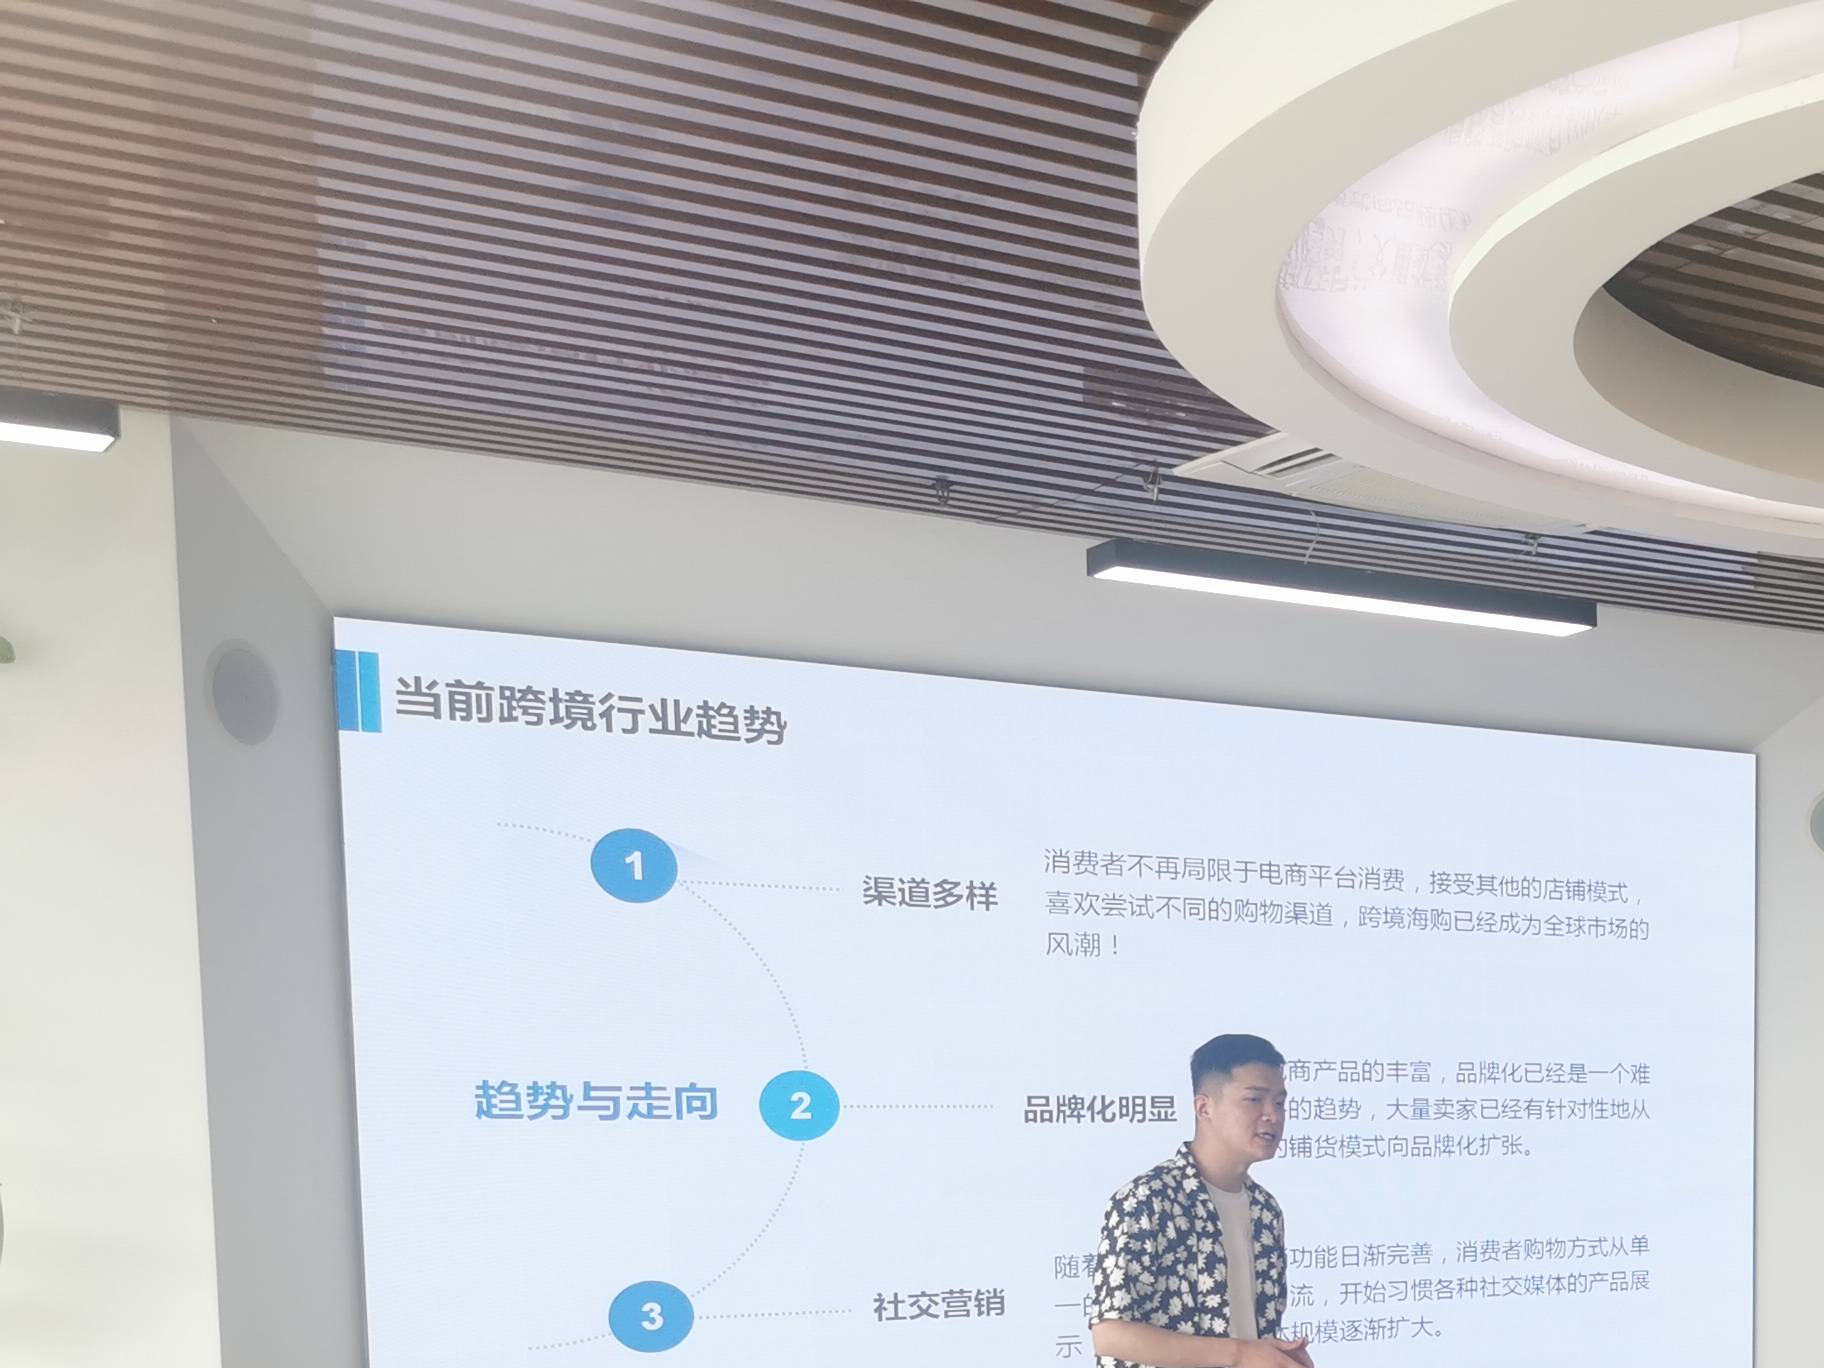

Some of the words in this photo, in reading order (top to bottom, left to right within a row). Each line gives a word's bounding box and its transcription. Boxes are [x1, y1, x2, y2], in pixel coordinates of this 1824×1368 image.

[394, 674, 788, 746] 当前跨境行业趋势
[623, 849, 645, 882] 1
[860, 874, 999, 912] 渠道多样
[1045, 890, 1650, 942] 喜欢尝试不同的购物渠道，跨境海购已经成为全球市场的
[1045, 930, 1120, 958] 风潮！
[1281, 1058, 1651, 1087] 商产品的丰富，品牌化已经是一个难
[474, 1079, 718, 1122] 趋势与走向
[789, 1091, 813, 1120] 2
[1023, 1094, 1178, 1125] 品牌化明显
[1282, 1096, 1651, 1124] 的趋势，大量卖家已经有针对性地从
[1284, 1234, 1651, 1272] 功能日渐完善，消费者购物方式从单
[640, 1301, 664, 1332] 3
[872, 1288, 1006, 1323] 社交营销
